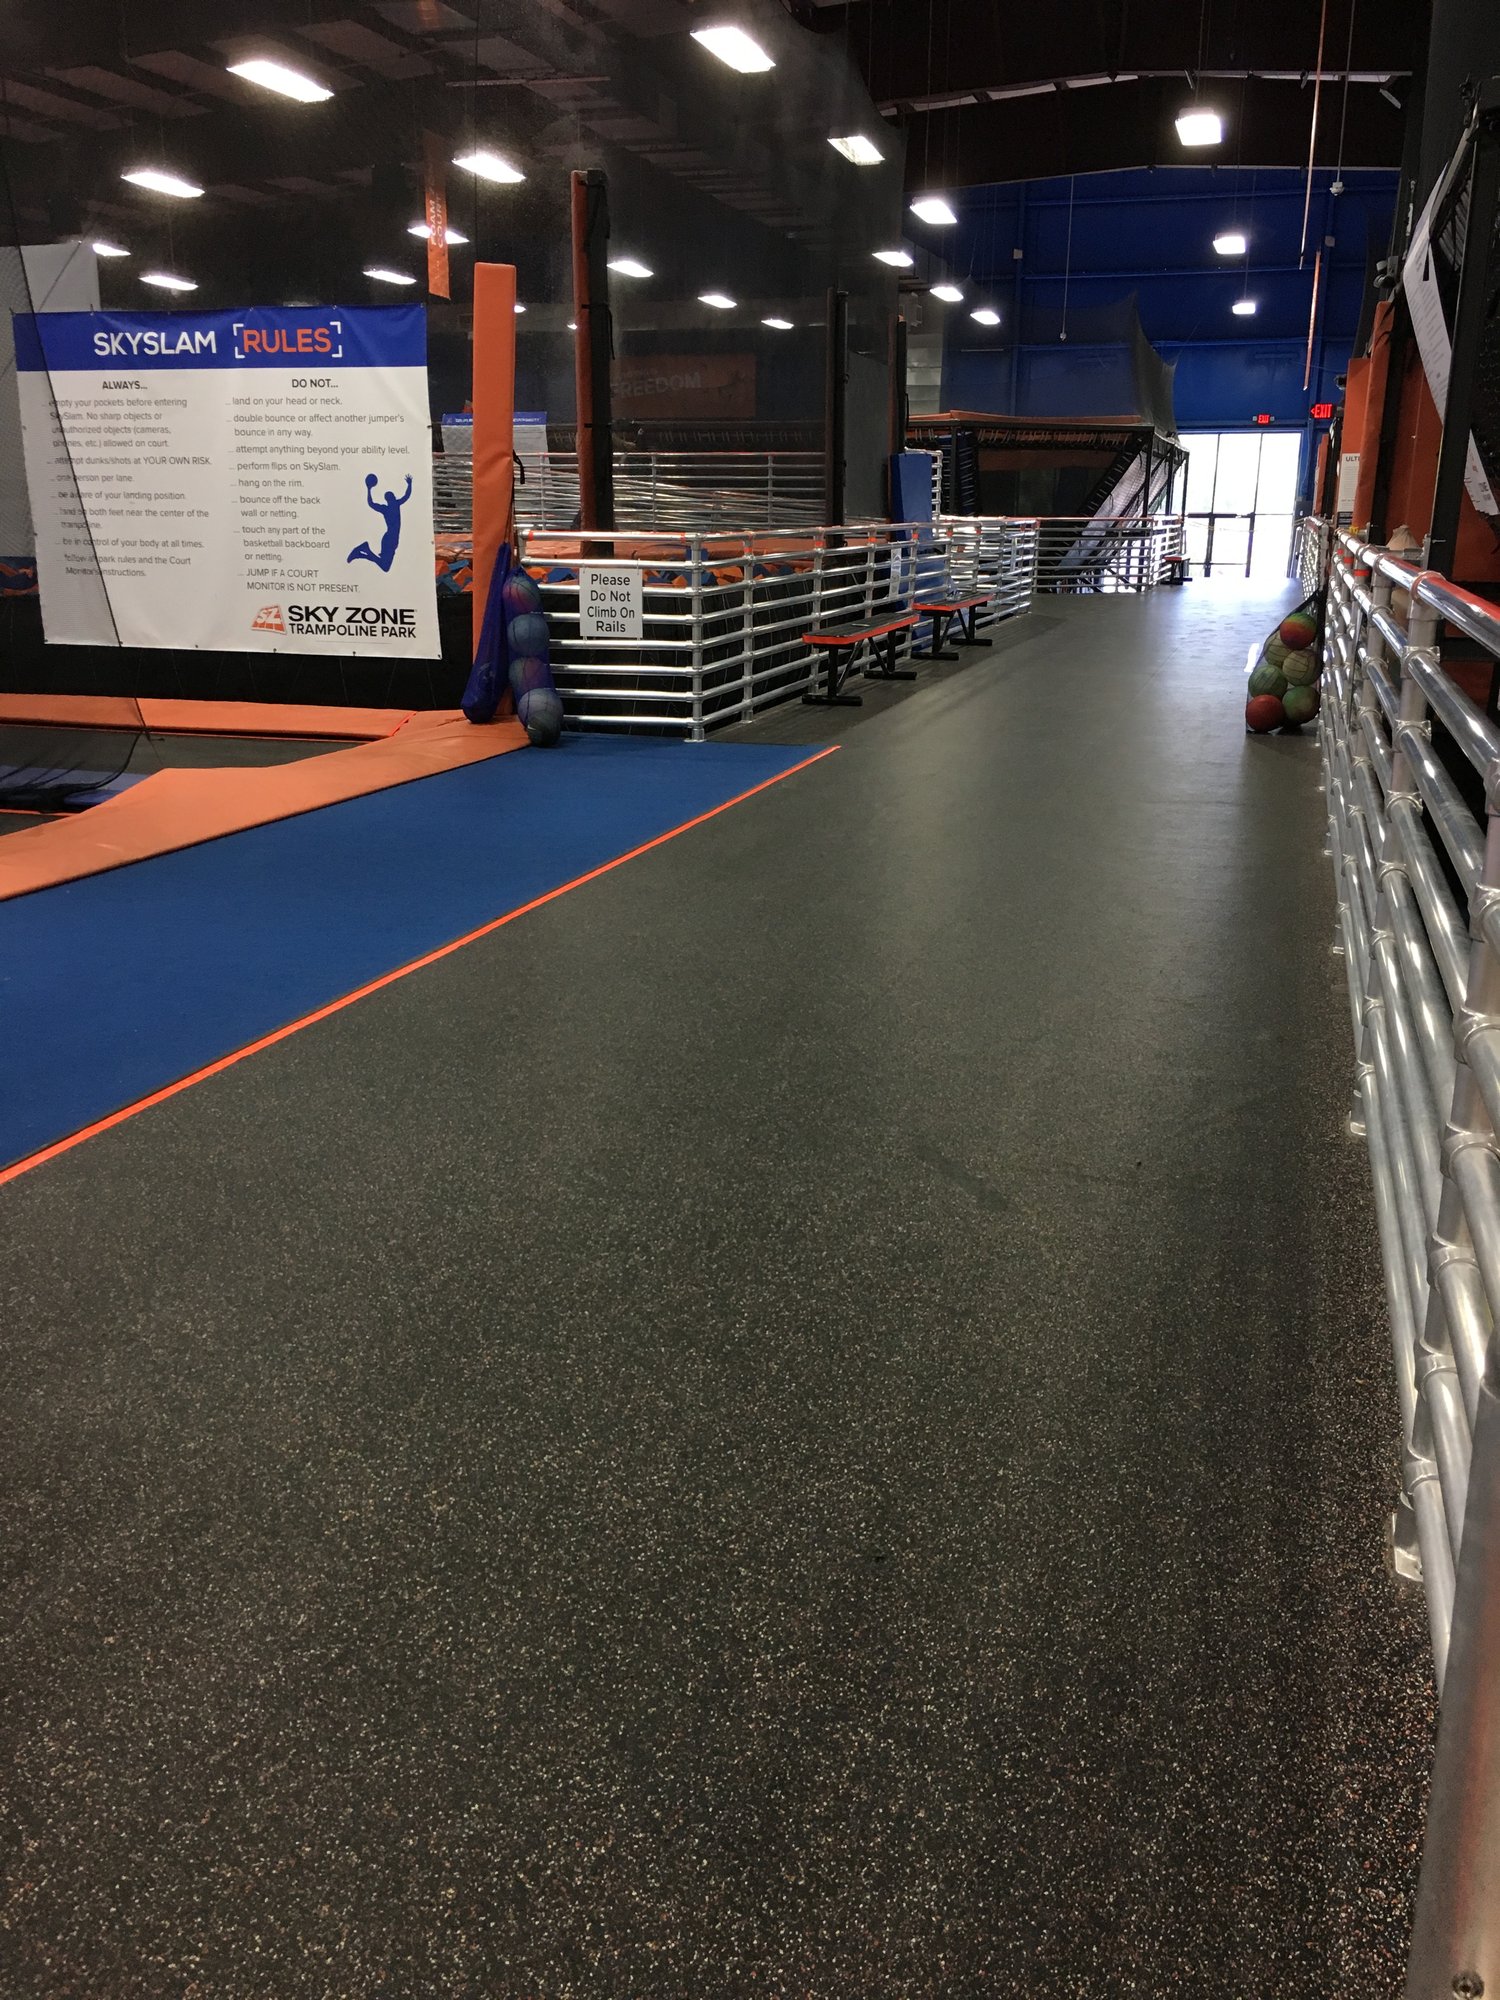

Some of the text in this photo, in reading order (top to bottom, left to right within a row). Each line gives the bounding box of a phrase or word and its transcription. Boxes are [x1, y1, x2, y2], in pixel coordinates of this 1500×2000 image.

[93, 327, 332, 356] SKYSLAM RULES
[292, 379, 307, 388] DO
[74, 400, 92, 408] your
[94, 399, 124, 408] pockets
[126, 399, 152, 407] before
[154, 399, 188, 409] entering
[232, 396, 250, 406] land
[253, 398, 264, 406] on
[264, 398, 284, 407] your
[286, 396, 308, 406] head
[320, 396, 343, 406] neck.
[1314, 404, 1333, 418] EXIT
[50, 412, 84, 421] SSlam.
[87, 412, 98, 420] No
[100, 412, 122, 421] sharp
[124, 412, 152, 421] objects
[234, 414, 263, 423] double
[265, 414, 296, 423] bounce
[308, 414, 332, 423] affect
[334, 414, 366, 423] another
[368, 414, 404, 424] jumper's
[1258, 414, 1270, 424] EXIT
[52, 426, 102, 434] unuthorized
[104, 425, 132, 434] objects
[234, 428, 313, 438] bounce in any way.
[104, 439, 132, 447] allowed
[236, 446, 410, 456] attempt anything beyond your ability level.
[143, 456, 168, 465] YOUR
[170, 456, 190, 465] OWN
[237, 462, 270, 472] perform
[271, 462, 288, 472] flips
[304, 462, 341, 472] SkySlam.
[102, 475, 114, 483] per
[238, 480, 260, 488] hang
[273, 480, 286, 488] the
[288, 480, 304, 488] rim.
[94, 491, 103, 499] of
[104, 492, 121, 500] your
[123, 491, 152, 501] landing
[240, 496, 320, 504] bounce off the back
[89, 508, 107, 516] both
[109, 508, 124, 516] feet
[145, 508, 158, 517] the
[160, 510, 185, 518] center
[187, 509, 195, 518] of
[196, 510, 210, 518] the
[241, 510, 299, 520] wall or netting.
[61, 522, 102, 530] trampoine.
[242, 526, 326, 536] touch any part of the
[111, 538, 120, 546] of
[140, 539, 160, 549] body
[162, 540, 170, 548] at
[171, 540, 180, 548] all
[182, 540, 205, 548] times.
[244, 539, 330, 549] basketball backboard
[88, 555, 98, 564] al
[100, 556, 116, 565] park
[118, 556, 137, 564] rules
[138, 556, 153, 564] and
[154, 556, 168, 565] the
[170, 556, 191, 565] Court
[244, 552, 283, 562] or netting.
[100, 568, 146, 577] nstructions.
[246, 568, 319, 578] JUMP IF A COURT
[591, 573, 631, 586] Please
[247, 582, 361, 594] MONITOR IS NOT PRESENT.
[590, 590, 631, 602] Do Not
[288, 605, 416, 625] SKY ZONE
[587, 606, 635, 619] Climb On
[289, 624, 416, 638] TRAMPOLINE PARK
[596, 620, 626, 632] Rails
